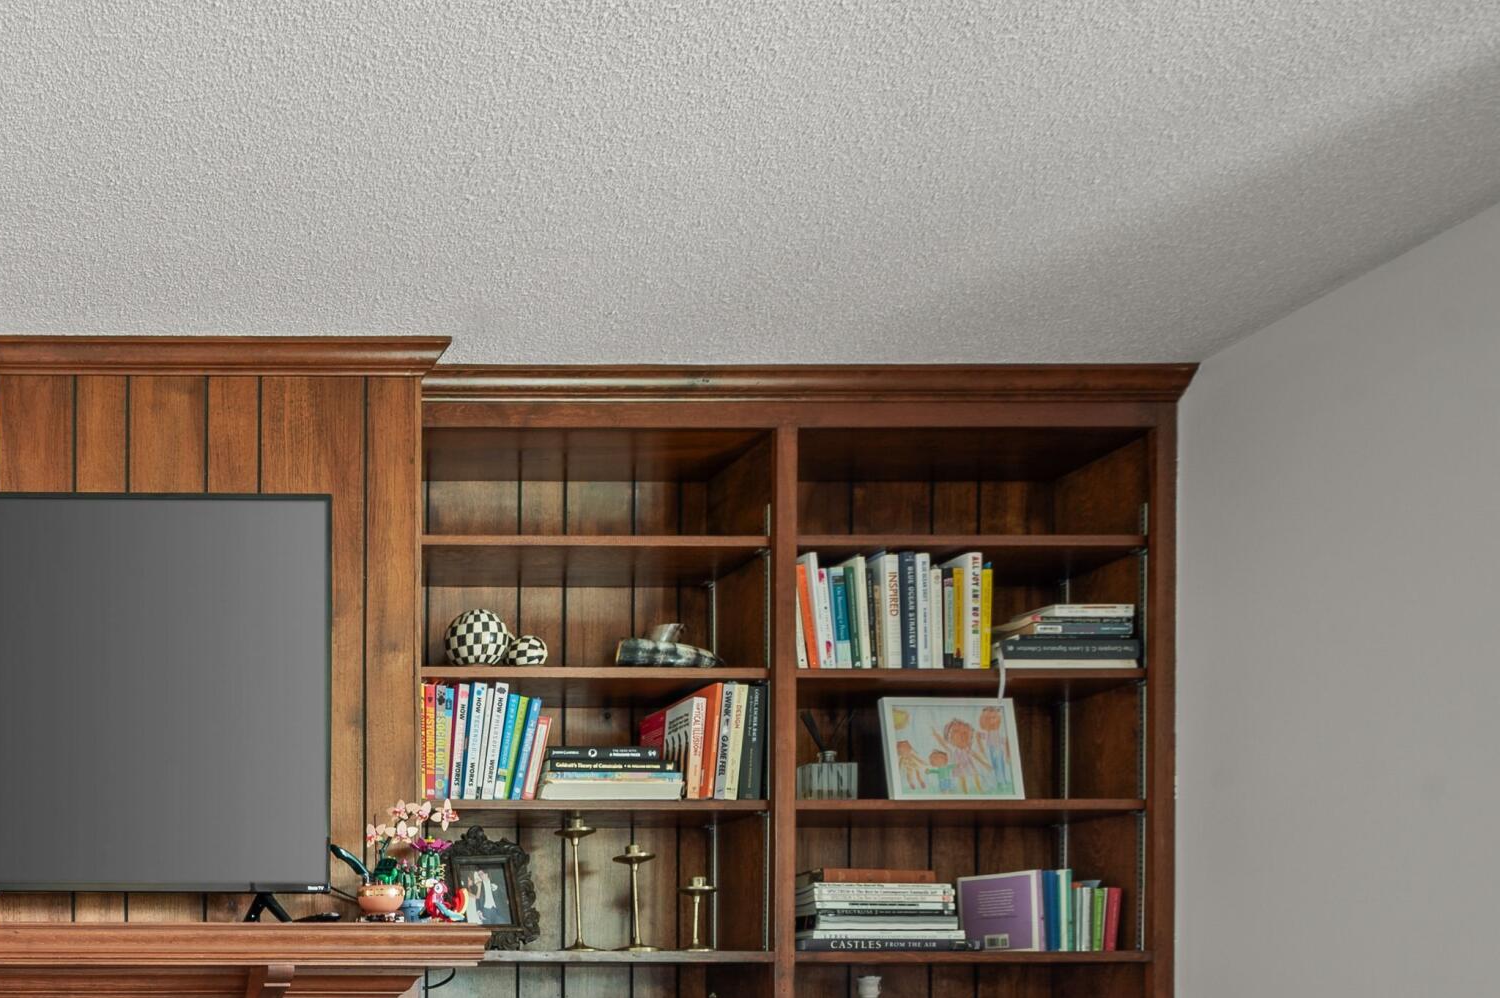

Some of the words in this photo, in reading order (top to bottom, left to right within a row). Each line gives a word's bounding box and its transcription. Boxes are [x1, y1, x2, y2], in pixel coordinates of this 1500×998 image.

[889, 572, 898, 616] INSPIRED
[972, 607, 980, 617] NO
[724, 691, 733, 717] SWINK
[427, 713, 435, 769] PSYCHOLOGY
[436, 717, 446, 768] SOCIOLOGY
[719, 735, 728, 759] GAME
[487, 760, 495, 783] WORKS
[830, 940, 881, 949] CASTLES
